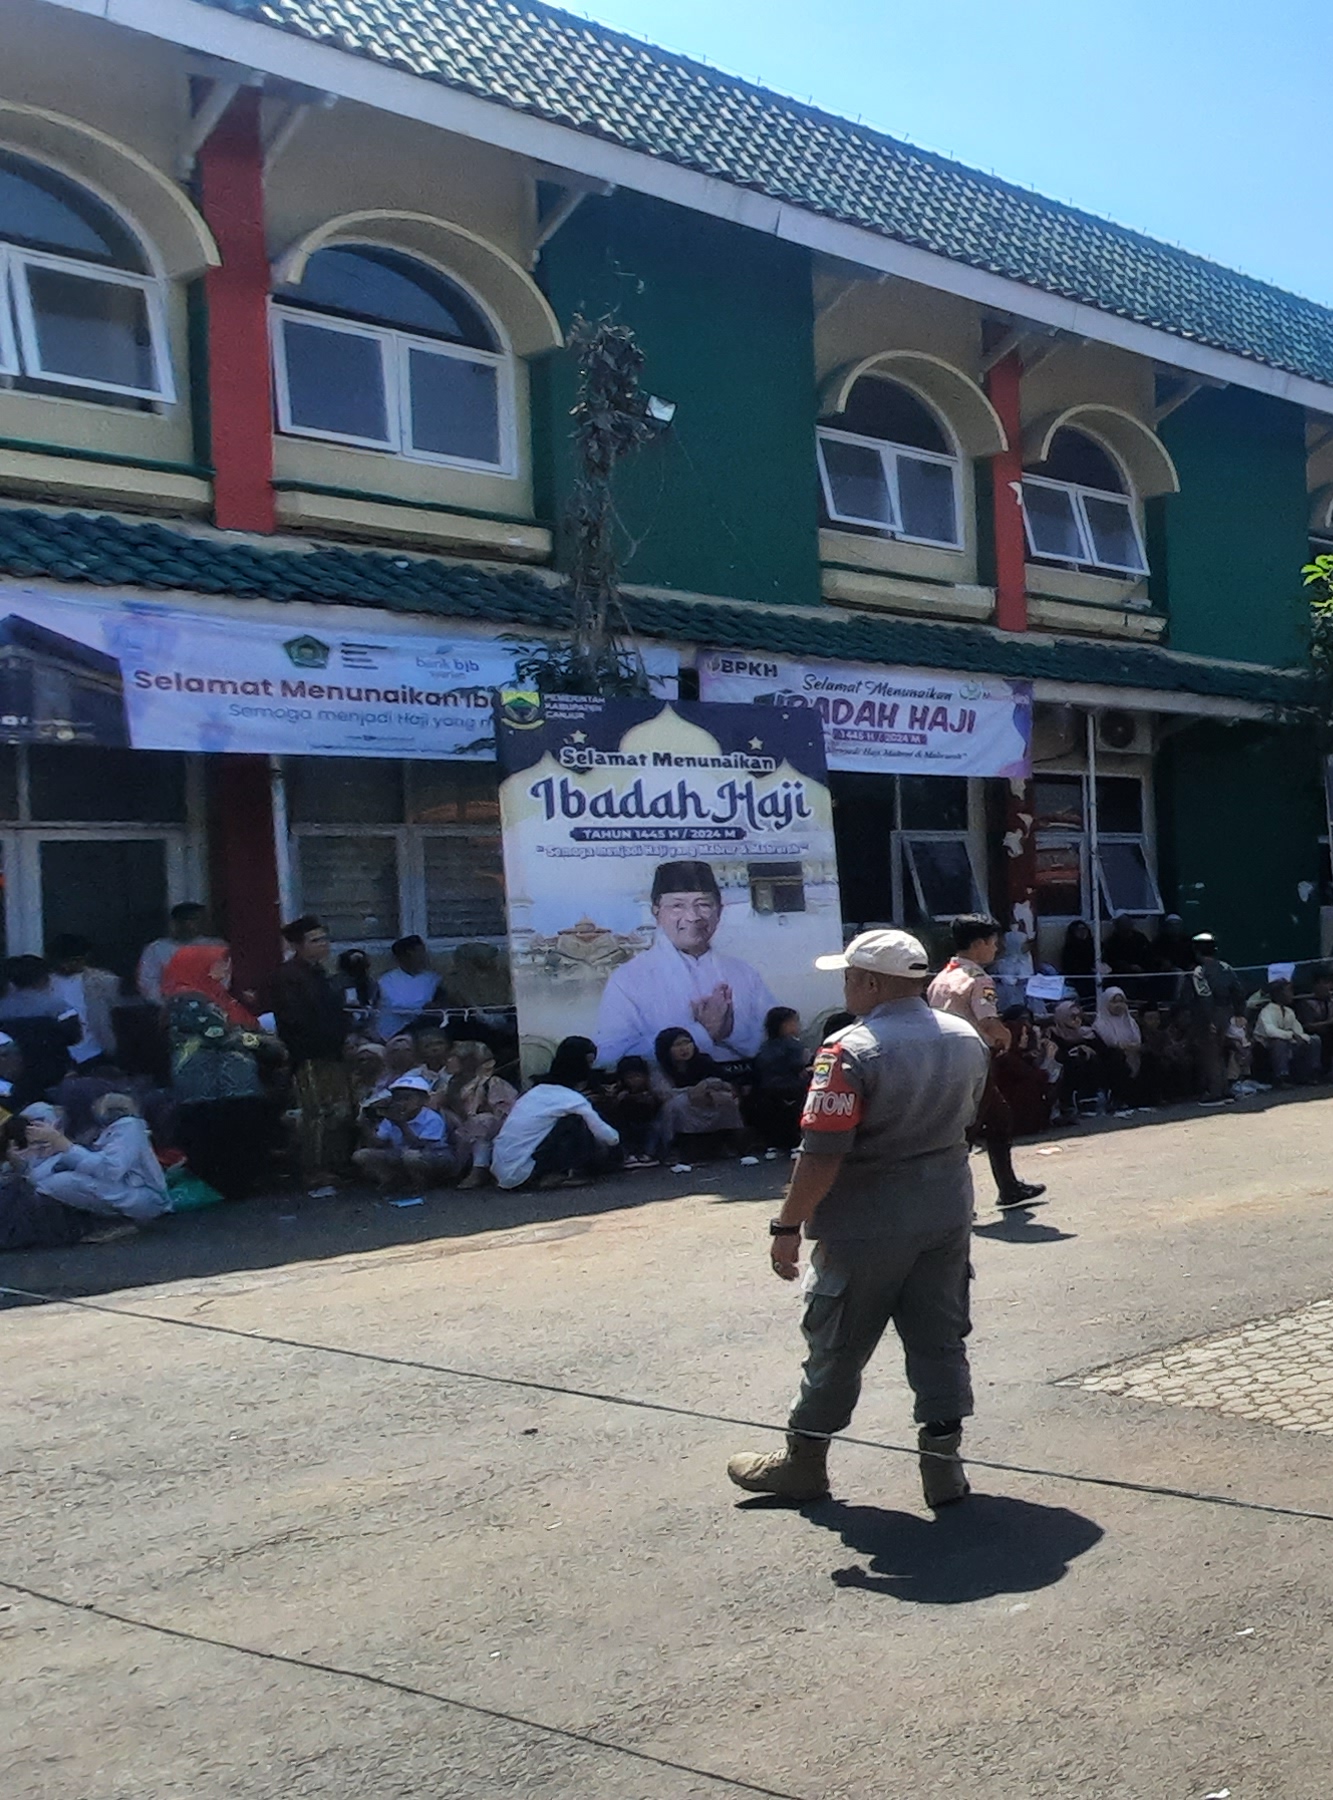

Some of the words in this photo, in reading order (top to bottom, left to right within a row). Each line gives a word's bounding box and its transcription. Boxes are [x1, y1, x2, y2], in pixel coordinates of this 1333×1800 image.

[453, 658, 480, 674] bjb
[720, 660, 778, 678] BPKH
[133, 669, 274, 698] Selamat
[280, 680, 459, 708] Menunaikan
[462, 687, 494, 709] Ib
[802, 673, 863, 694] Selamat
[864, 680, 953, 701] Menunaikan
[228, 702, 313, 724] Semoga
[316, 706, 391, 731] menjadi
[397, 712, 429, 730] Haji
[431, 715, 476, 733] yang
[909, 704, 977, 735] HAJI
[561, 748, 647, 768] Selamat
[652, 752, 775, 770] Menunaikan
[530, 776, 711, 821] Ibadah
[711, 779, 812, 831] Haji
[582, 829, 633, 840] TAHUN
[635, 829, 665, 839] 1445
[669, 829, 680, 839] H
[689, 829, 721, 839] 2024
[724, 829, 736, 839] M
